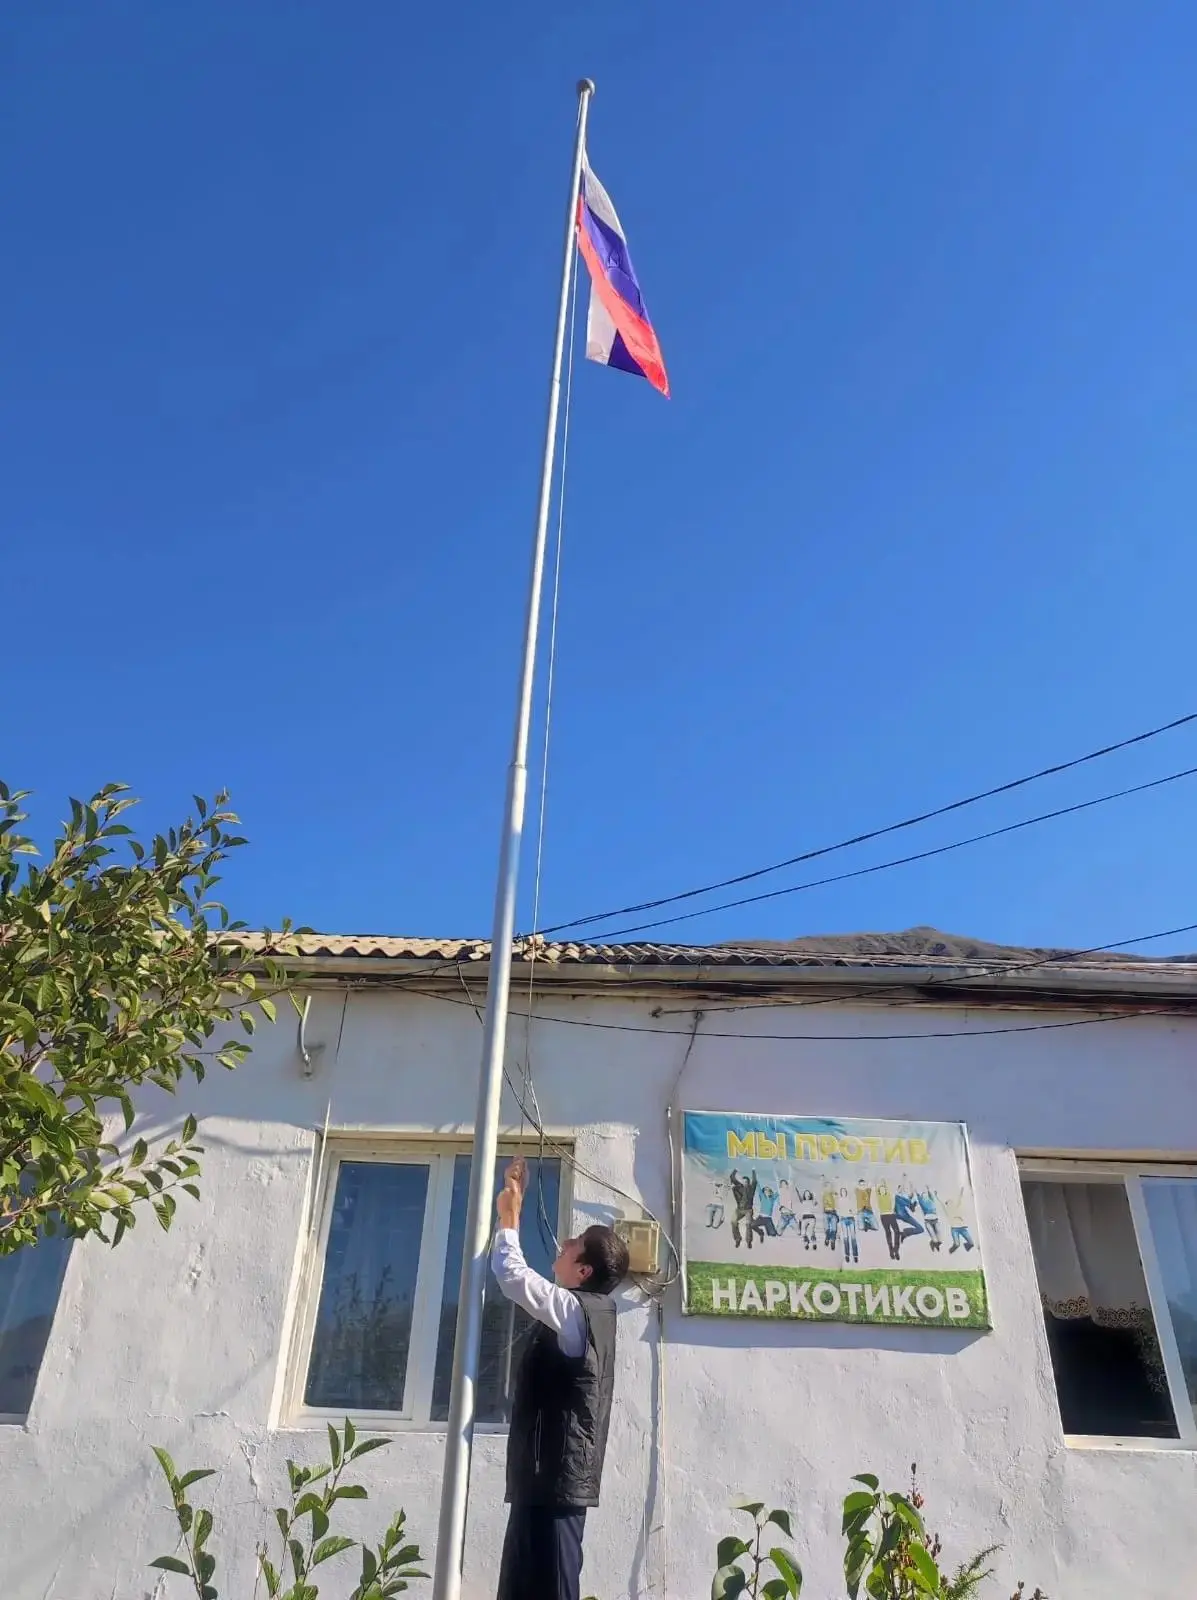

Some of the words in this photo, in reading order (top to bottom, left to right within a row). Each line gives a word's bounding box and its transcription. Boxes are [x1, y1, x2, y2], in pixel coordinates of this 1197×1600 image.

[727, 1131, 787, 1160] МЫ
[795, 1133, 930, 1164] ПРОТИВ
[712, 1278, 971, 1318] НАРКОТИКОВ
